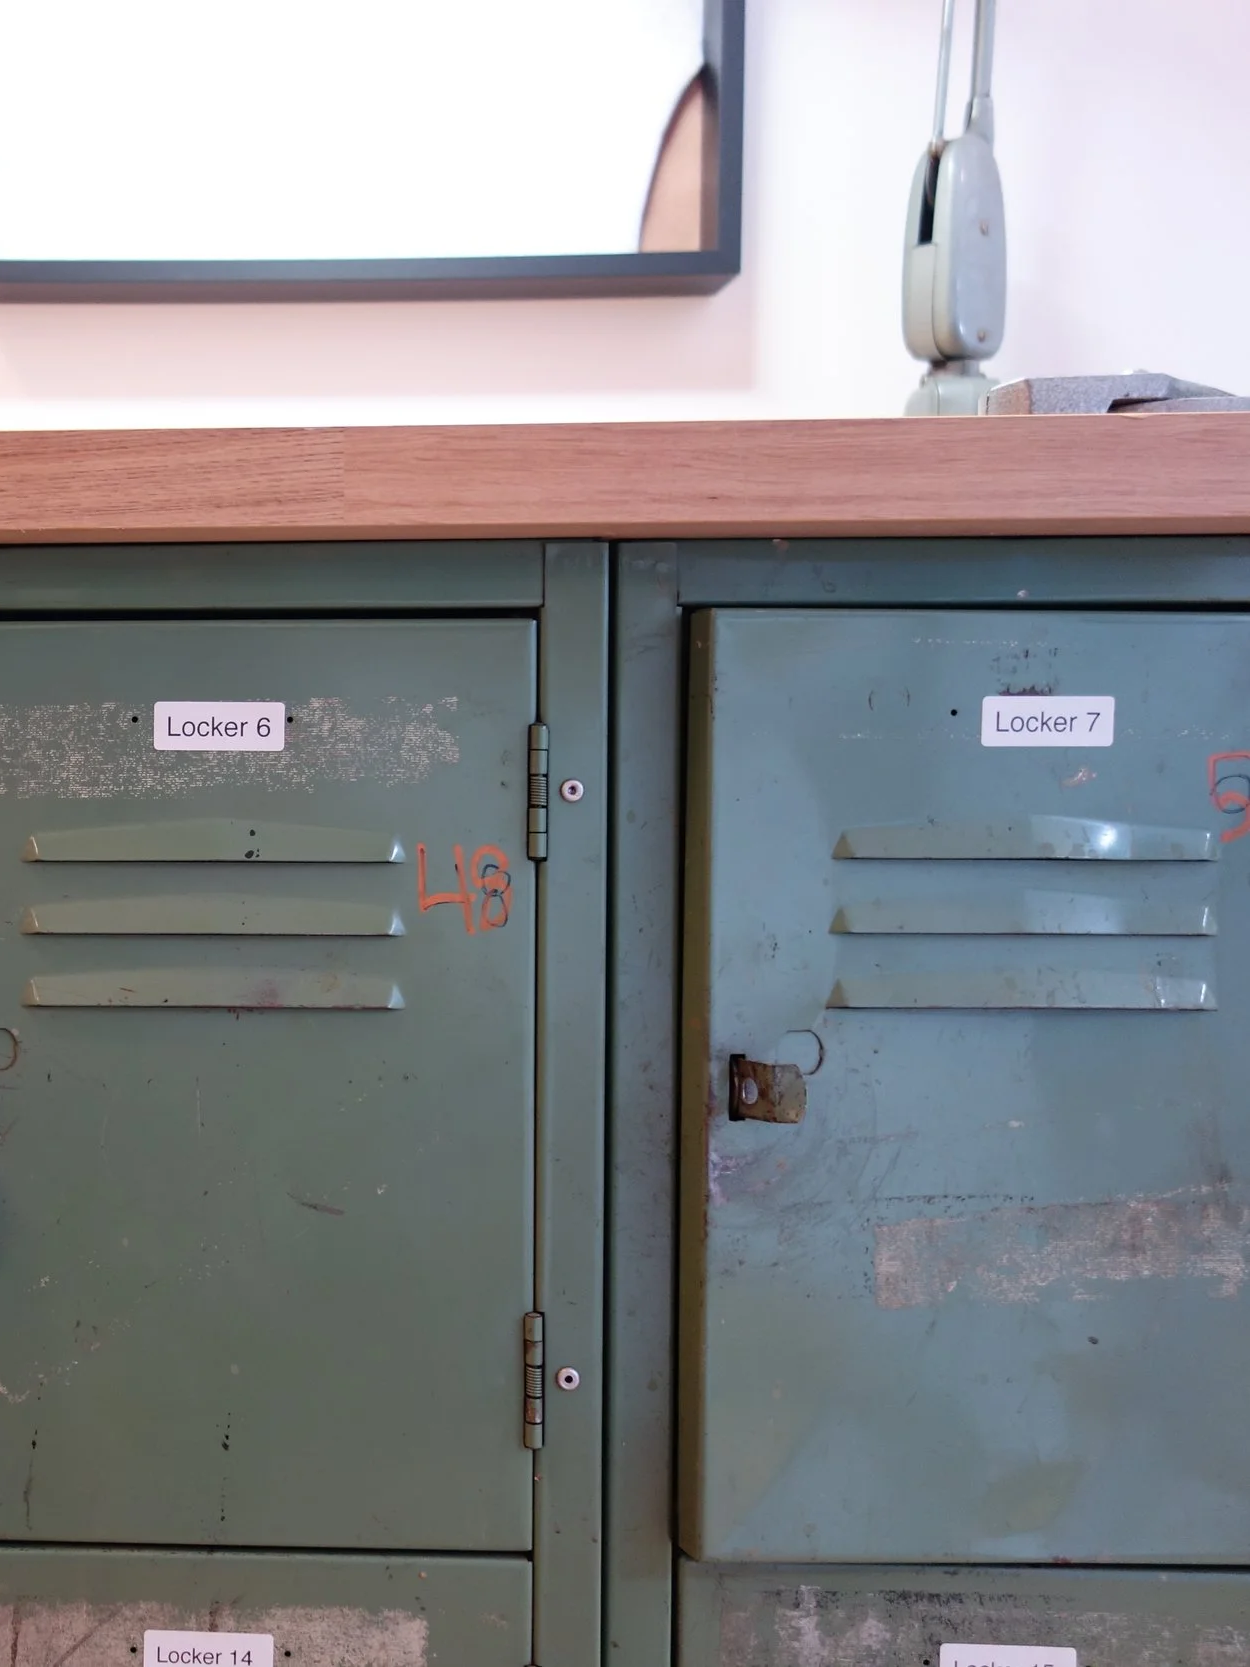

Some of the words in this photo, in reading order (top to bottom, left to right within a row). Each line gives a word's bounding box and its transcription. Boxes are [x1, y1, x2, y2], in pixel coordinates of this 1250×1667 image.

[166, 716, 248, 739] Locker
[255, 716, 272, 738] 6
[996, 711, 1078, 732] Locker
[1086, 712, 1100, 732] 7
[156, 1646, 223, 1665] Locker
[230, 1649, 253, 1666] 14
